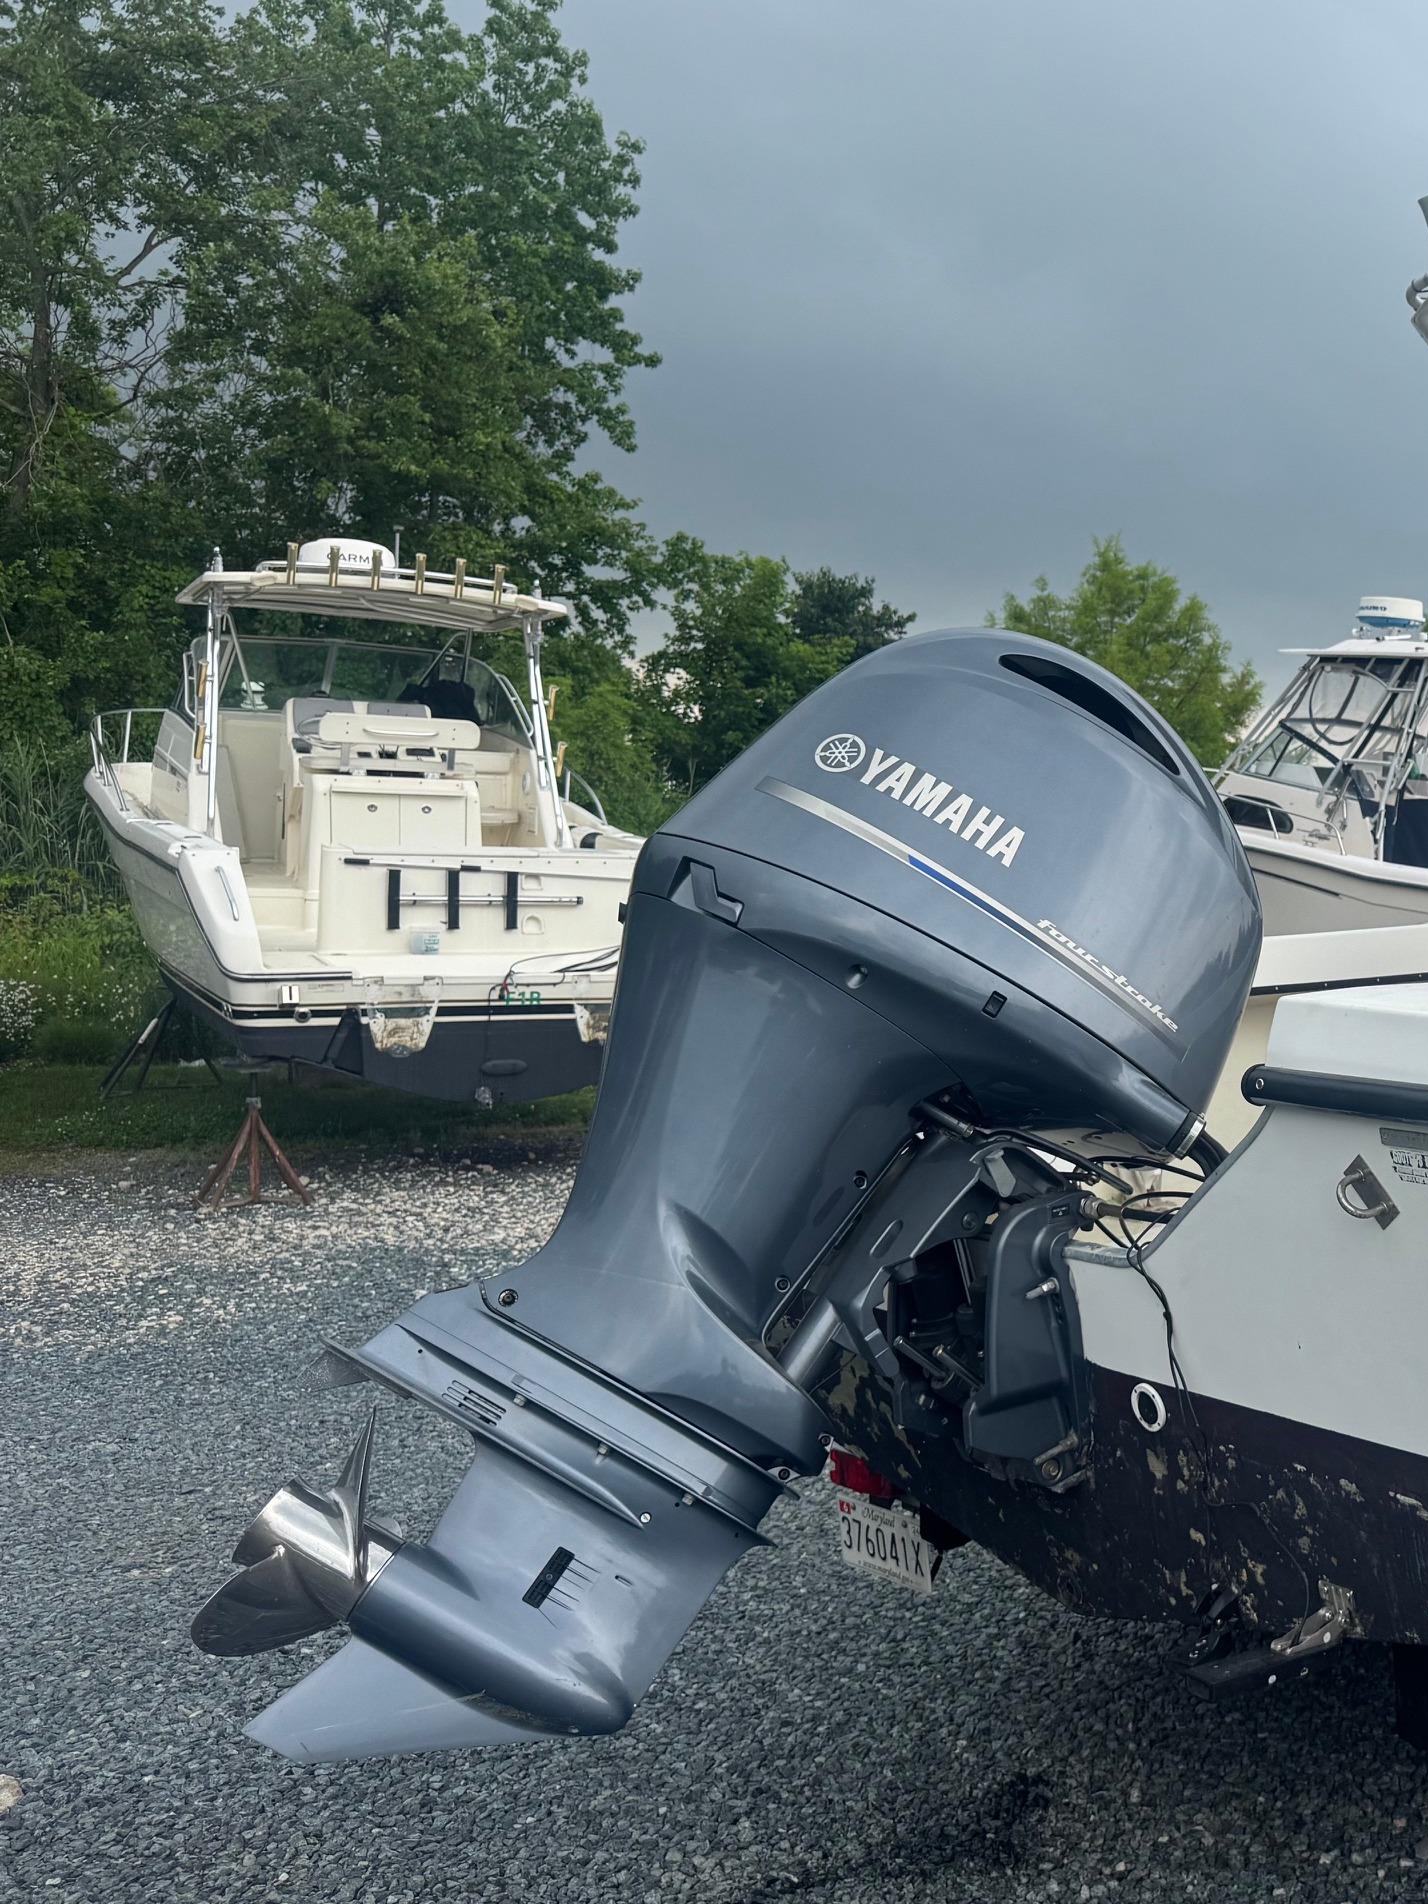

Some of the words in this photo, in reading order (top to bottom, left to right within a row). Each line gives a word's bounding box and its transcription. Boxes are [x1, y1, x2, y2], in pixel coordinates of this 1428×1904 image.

[859, 747, 1027, 868] YAMAHA
[841, 1515, 925, 1577] 376041X
[862, 1507, 895, 1529] Maryland
